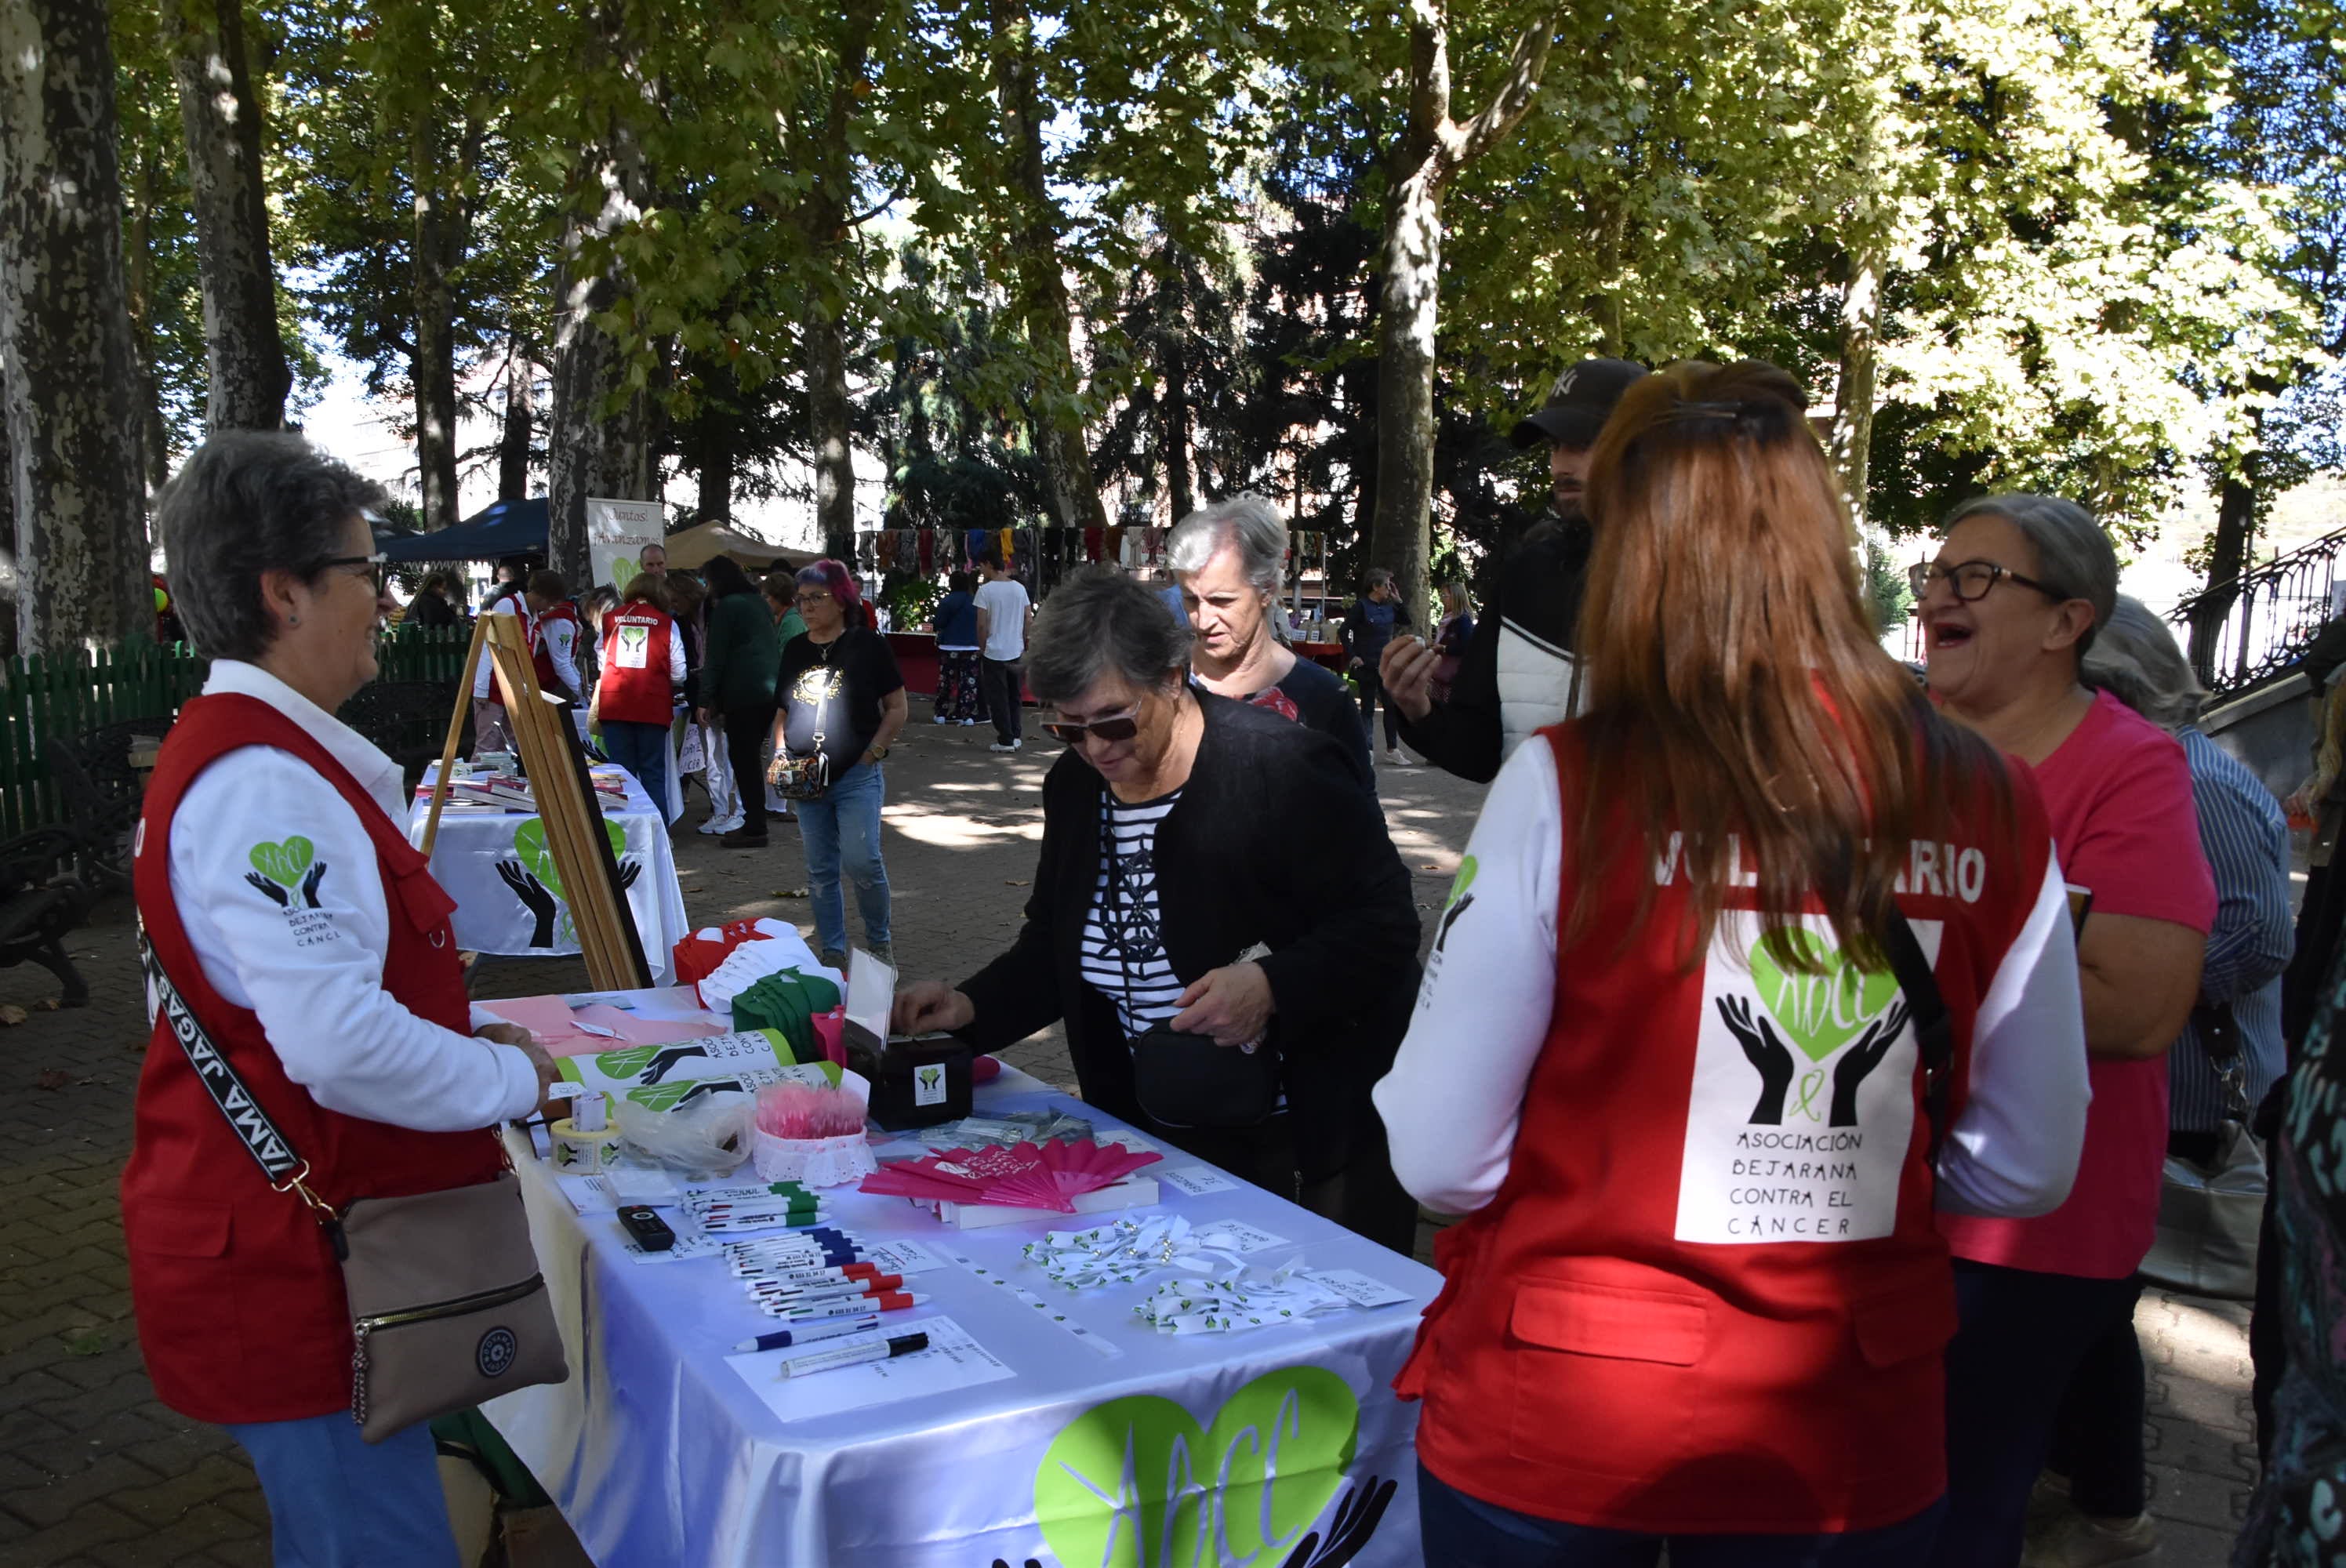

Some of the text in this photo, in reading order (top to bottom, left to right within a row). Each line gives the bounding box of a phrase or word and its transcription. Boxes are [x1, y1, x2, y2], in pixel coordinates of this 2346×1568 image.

[615, 615, 658, 626] VOLUNTARIO
[158, 975, 225, 1079] JAGAS
[1737, 1131, 1862, 1152] ASOCIACIÓN
[1732, 1159, 1857, 1181] BEJARANA
[1730, 1188, 1853, 1207] CONTRA EL
[1727, 1215, 1850, 1236] CÁNCER
